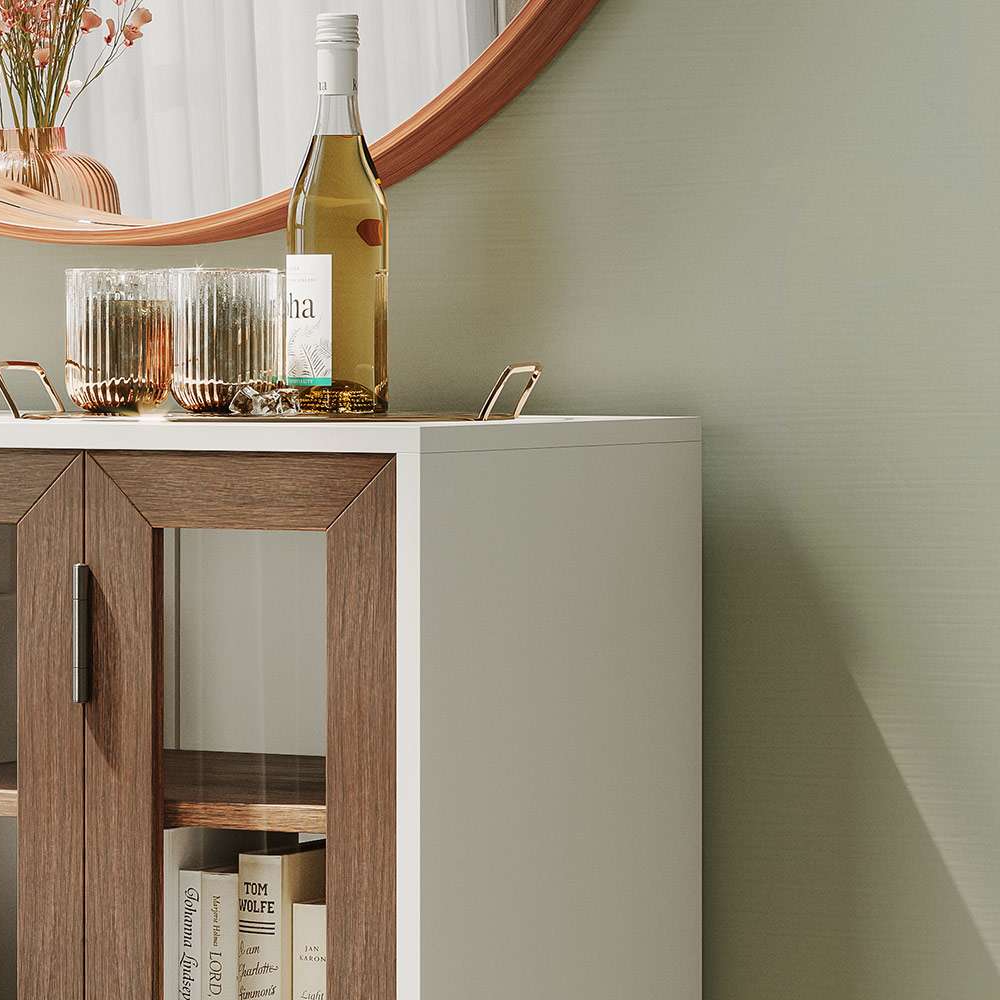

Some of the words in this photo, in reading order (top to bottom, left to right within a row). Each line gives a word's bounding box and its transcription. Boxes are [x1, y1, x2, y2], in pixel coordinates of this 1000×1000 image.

[243, 881, 268, 895] TOM
[238, 900, 275, 914] WOLFE
[183, 887, 199, 948] Johanna
[246, 945, 260, 955] am
[207, 951, 222, 997] LORD,
[237, 961, 279, 982] Charlotte
